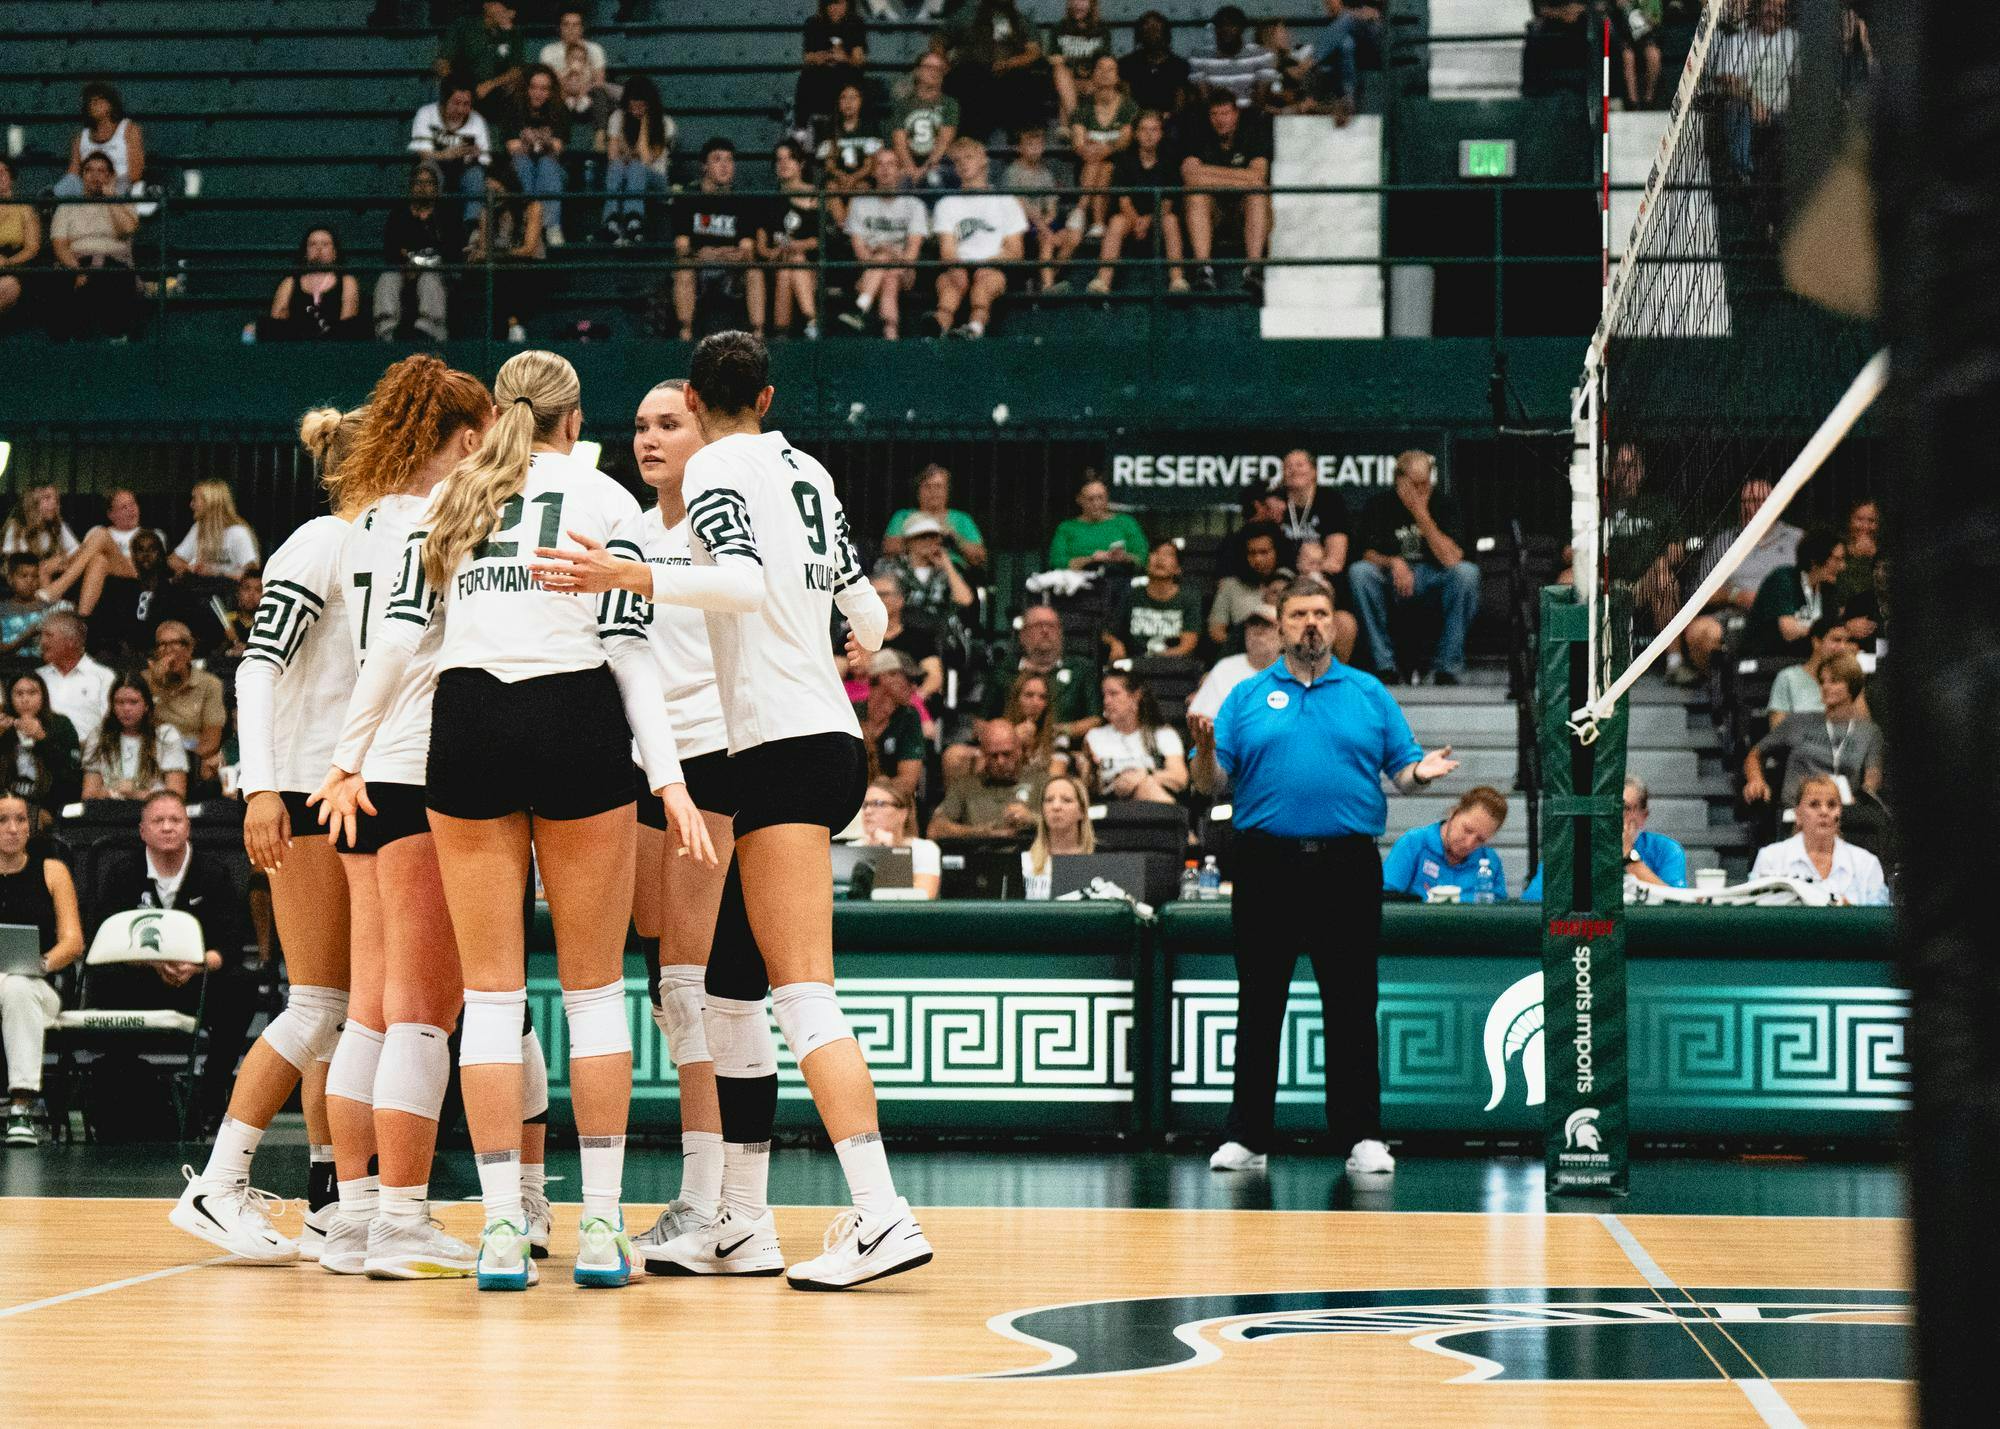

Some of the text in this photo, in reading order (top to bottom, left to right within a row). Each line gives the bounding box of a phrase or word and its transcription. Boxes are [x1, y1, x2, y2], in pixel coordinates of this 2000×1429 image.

[1113, 456, 1438, 490] RESERVED EATI
[473, 491, 565, 561] 21
[791, 480, 827, 556] 9
[136, 591, 149, 621] 8
[353, 572, 372, 650] 7
[84, 1016, 144, 1028] SPARTANS
[1572, 946, 1594, 1094] sports imports
